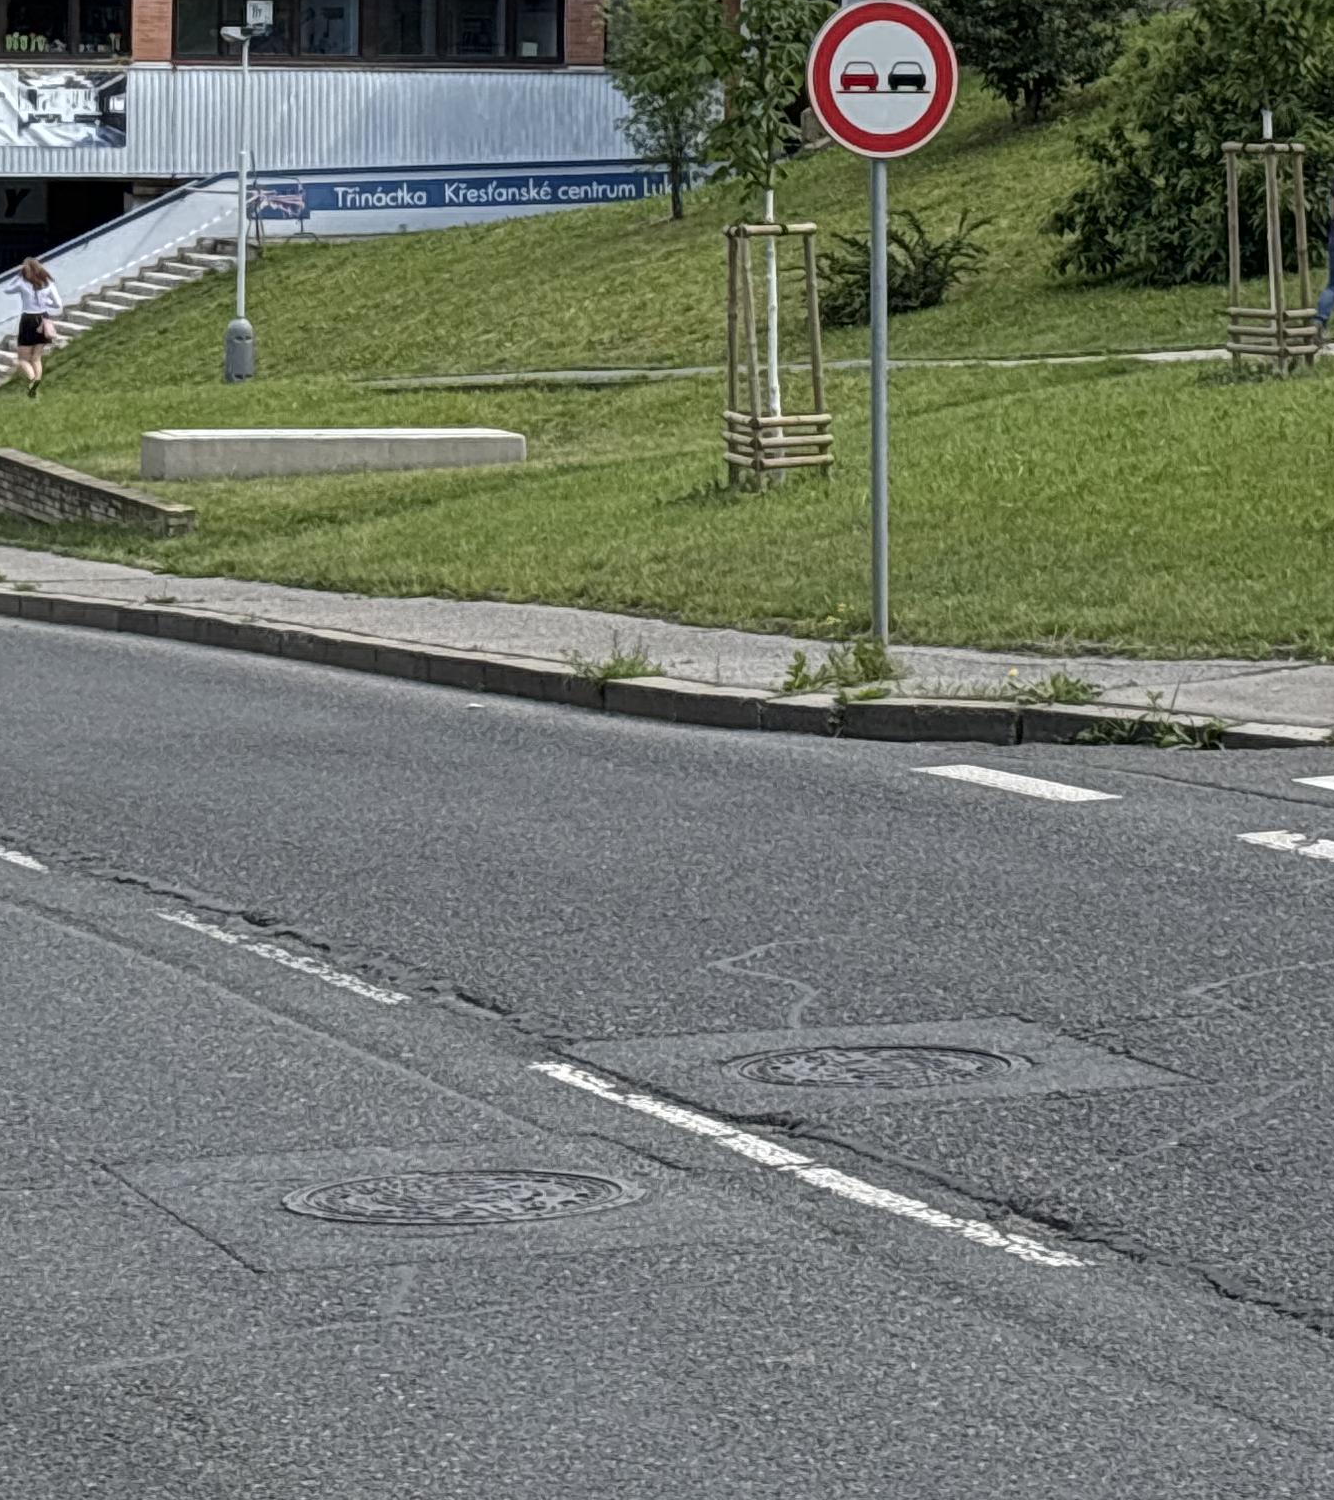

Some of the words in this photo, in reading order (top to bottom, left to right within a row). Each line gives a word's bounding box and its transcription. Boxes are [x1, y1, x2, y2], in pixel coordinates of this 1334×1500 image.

[334, 182, 427, 208] Třináctka
[444, 177, 552, 205] Křesťanské
[557, 180, 636, 200] centrum
